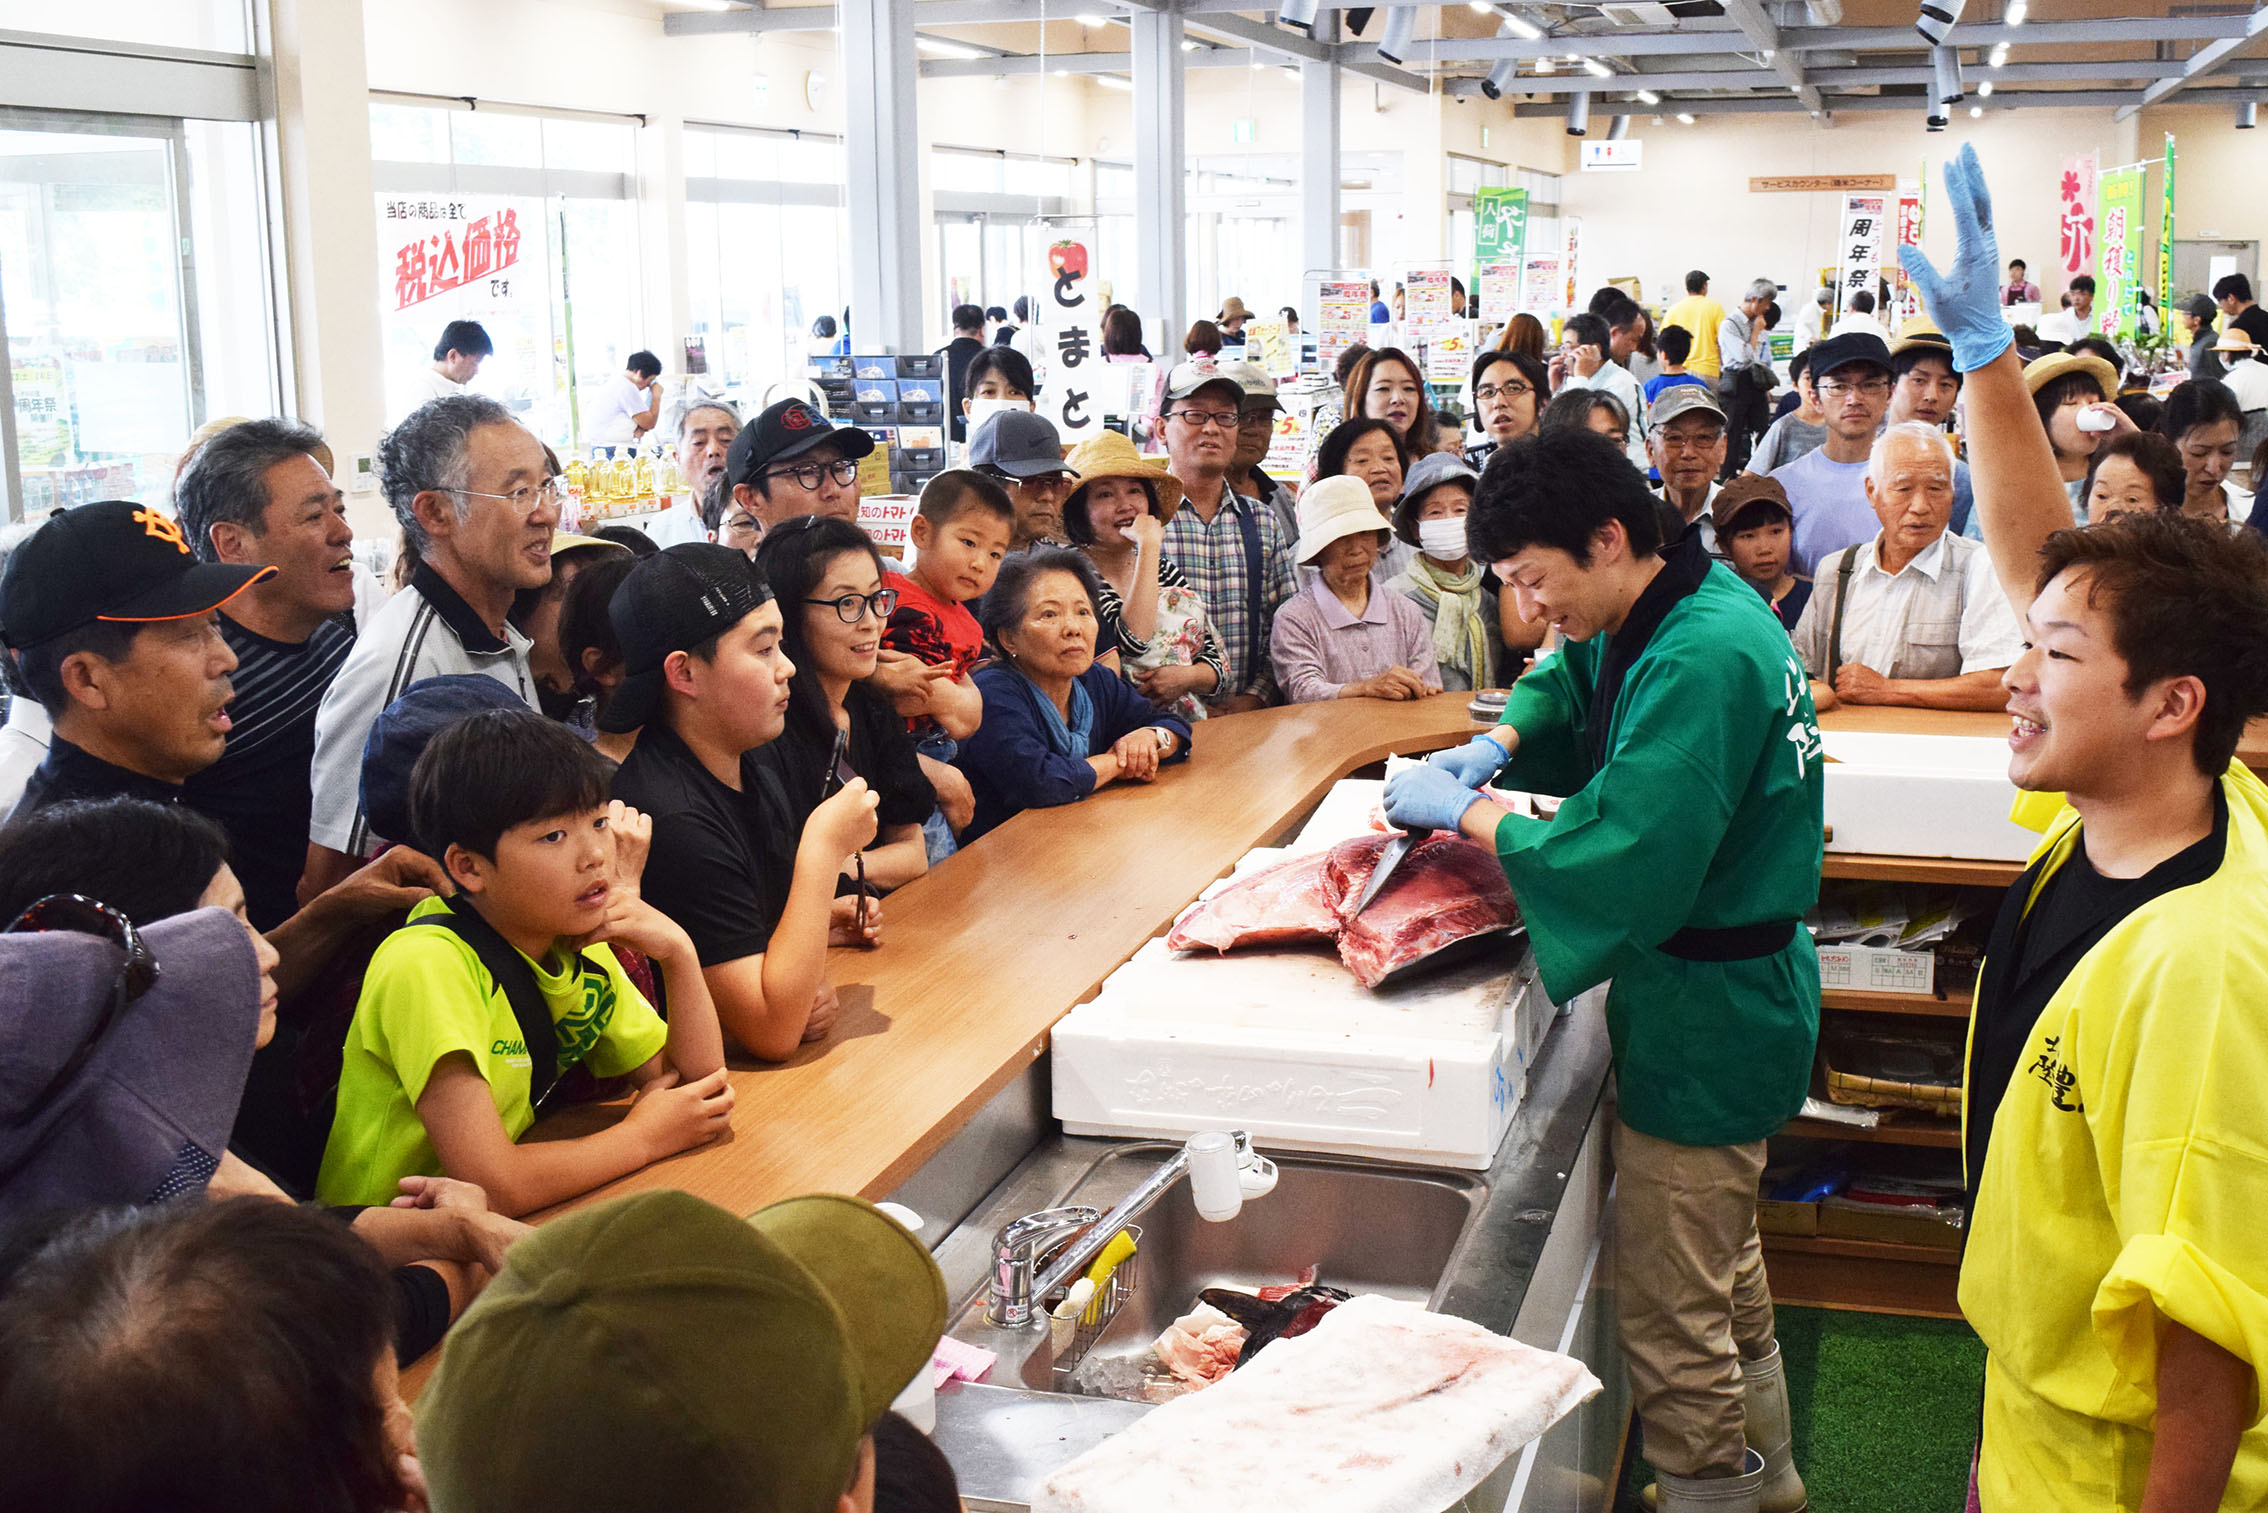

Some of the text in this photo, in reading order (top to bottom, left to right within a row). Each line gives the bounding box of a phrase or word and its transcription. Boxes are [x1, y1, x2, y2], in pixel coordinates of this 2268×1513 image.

[386, 200, 467, 220] 当店の商品は全て
[395, 207, 521, 308] 税込価格
[1846, 218, 1873, 288] 周年祭
[1053, 266, 1091, 429] とまと
